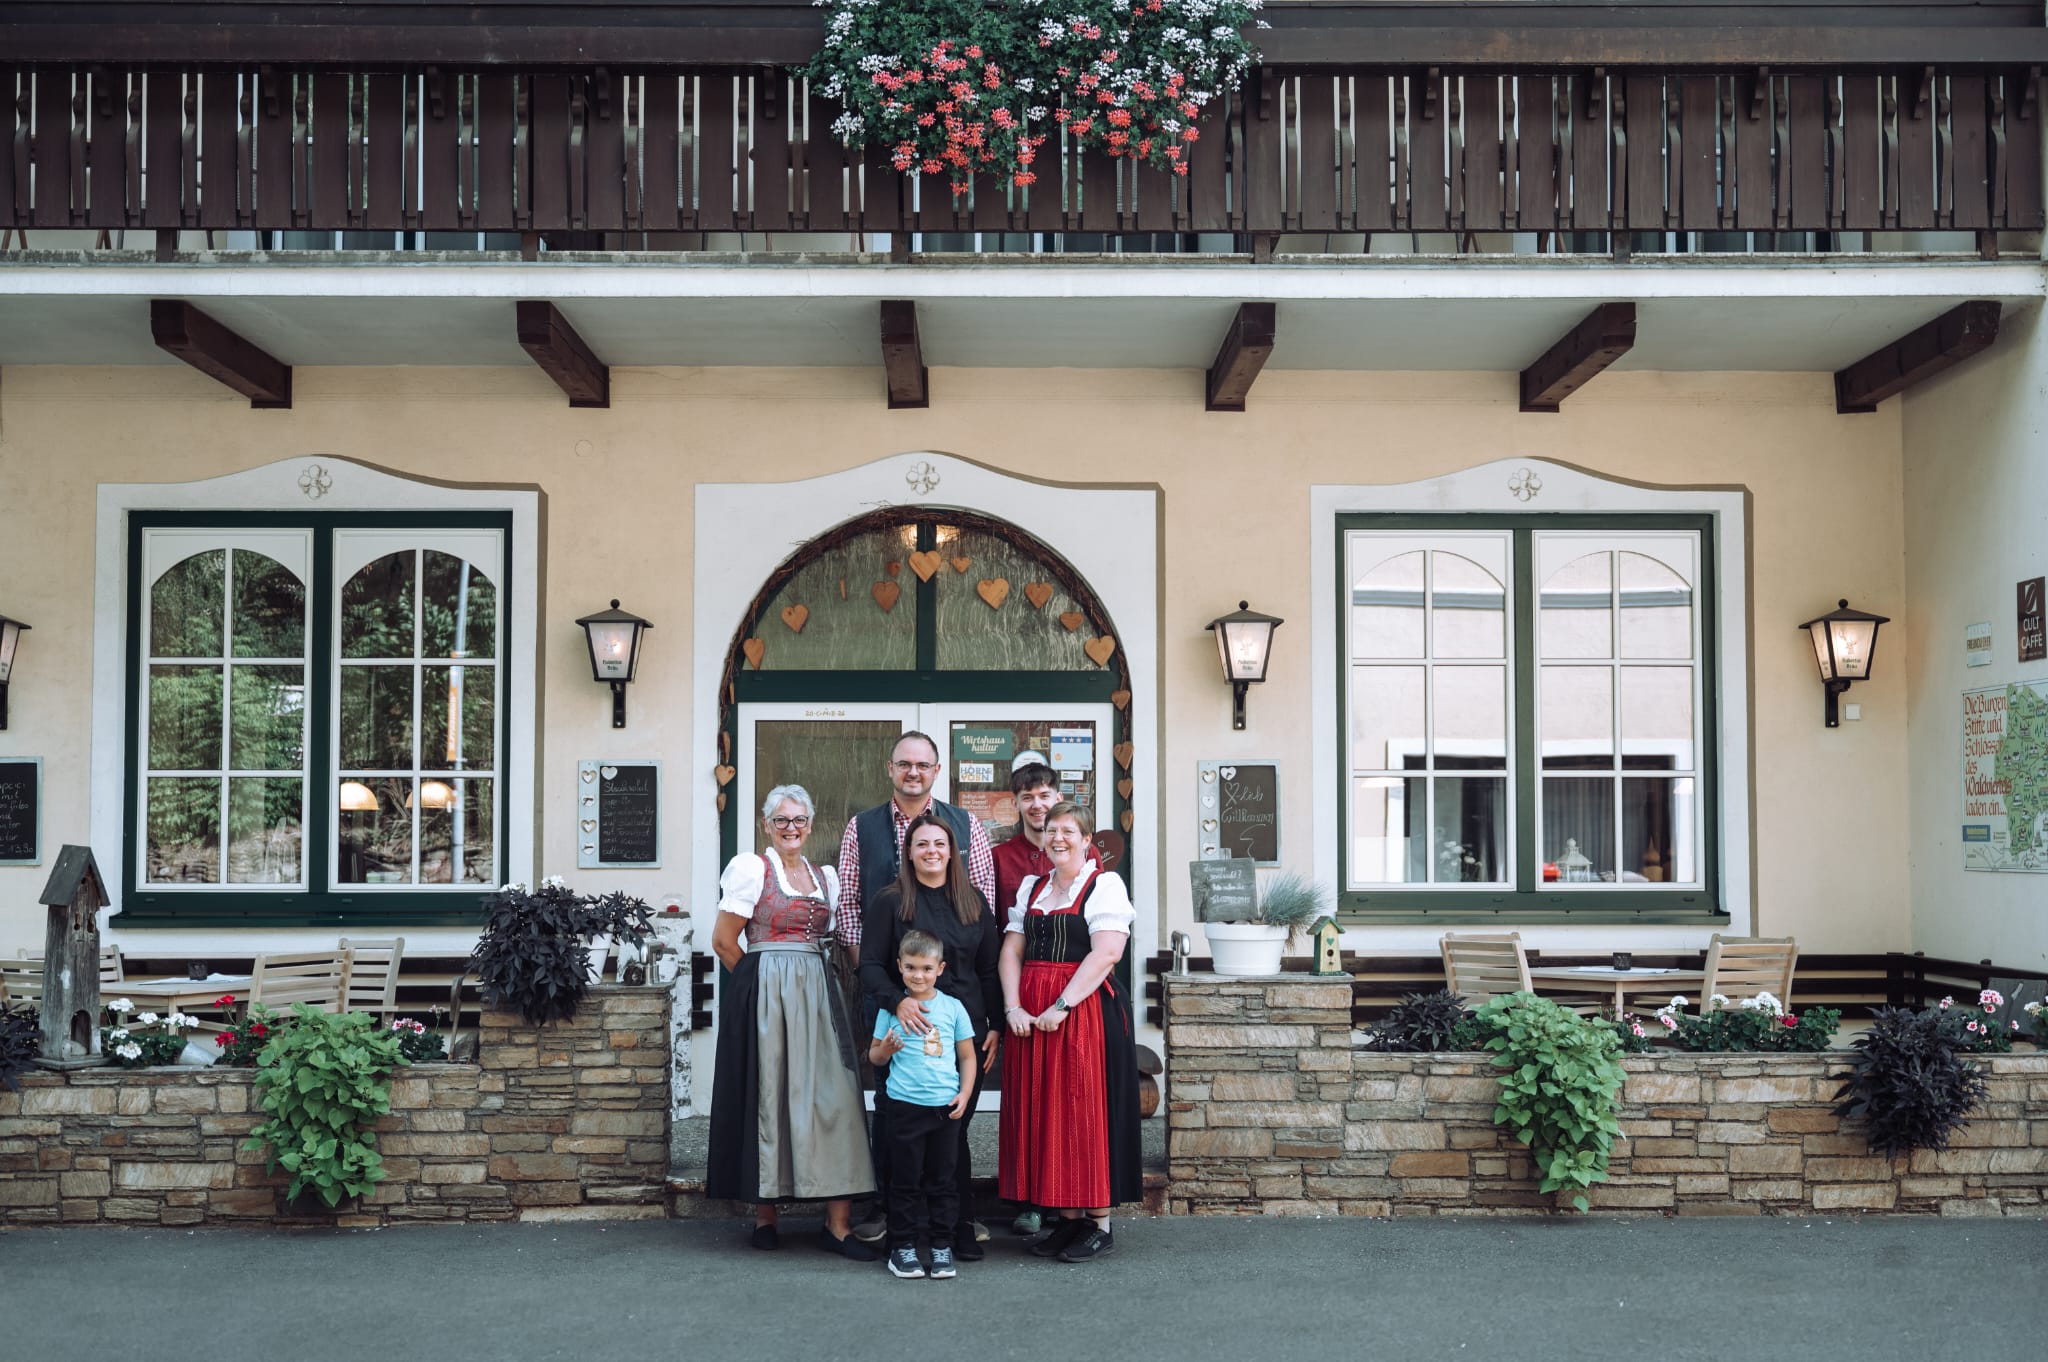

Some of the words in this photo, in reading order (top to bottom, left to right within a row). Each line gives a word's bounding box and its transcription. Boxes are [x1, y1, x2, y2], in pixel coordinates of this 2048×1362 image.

[2023, 616, 2040, 632] CULT
[2021, 631, 2043, 650] CAFFÈ
[1965, 696, 1976, 715] Die
[1965, 715, 1985, 737] Stifte
[1986, 714, 2003, 734] und
[960, 735, 1005, 745] Wirtshaus
[971, 743, 999, 753] kultur
[1965, 759, 1978, 776] des
[1965, 773, 2012, 797] Waldviertels
[1966, 799, 1987, 817] laden
